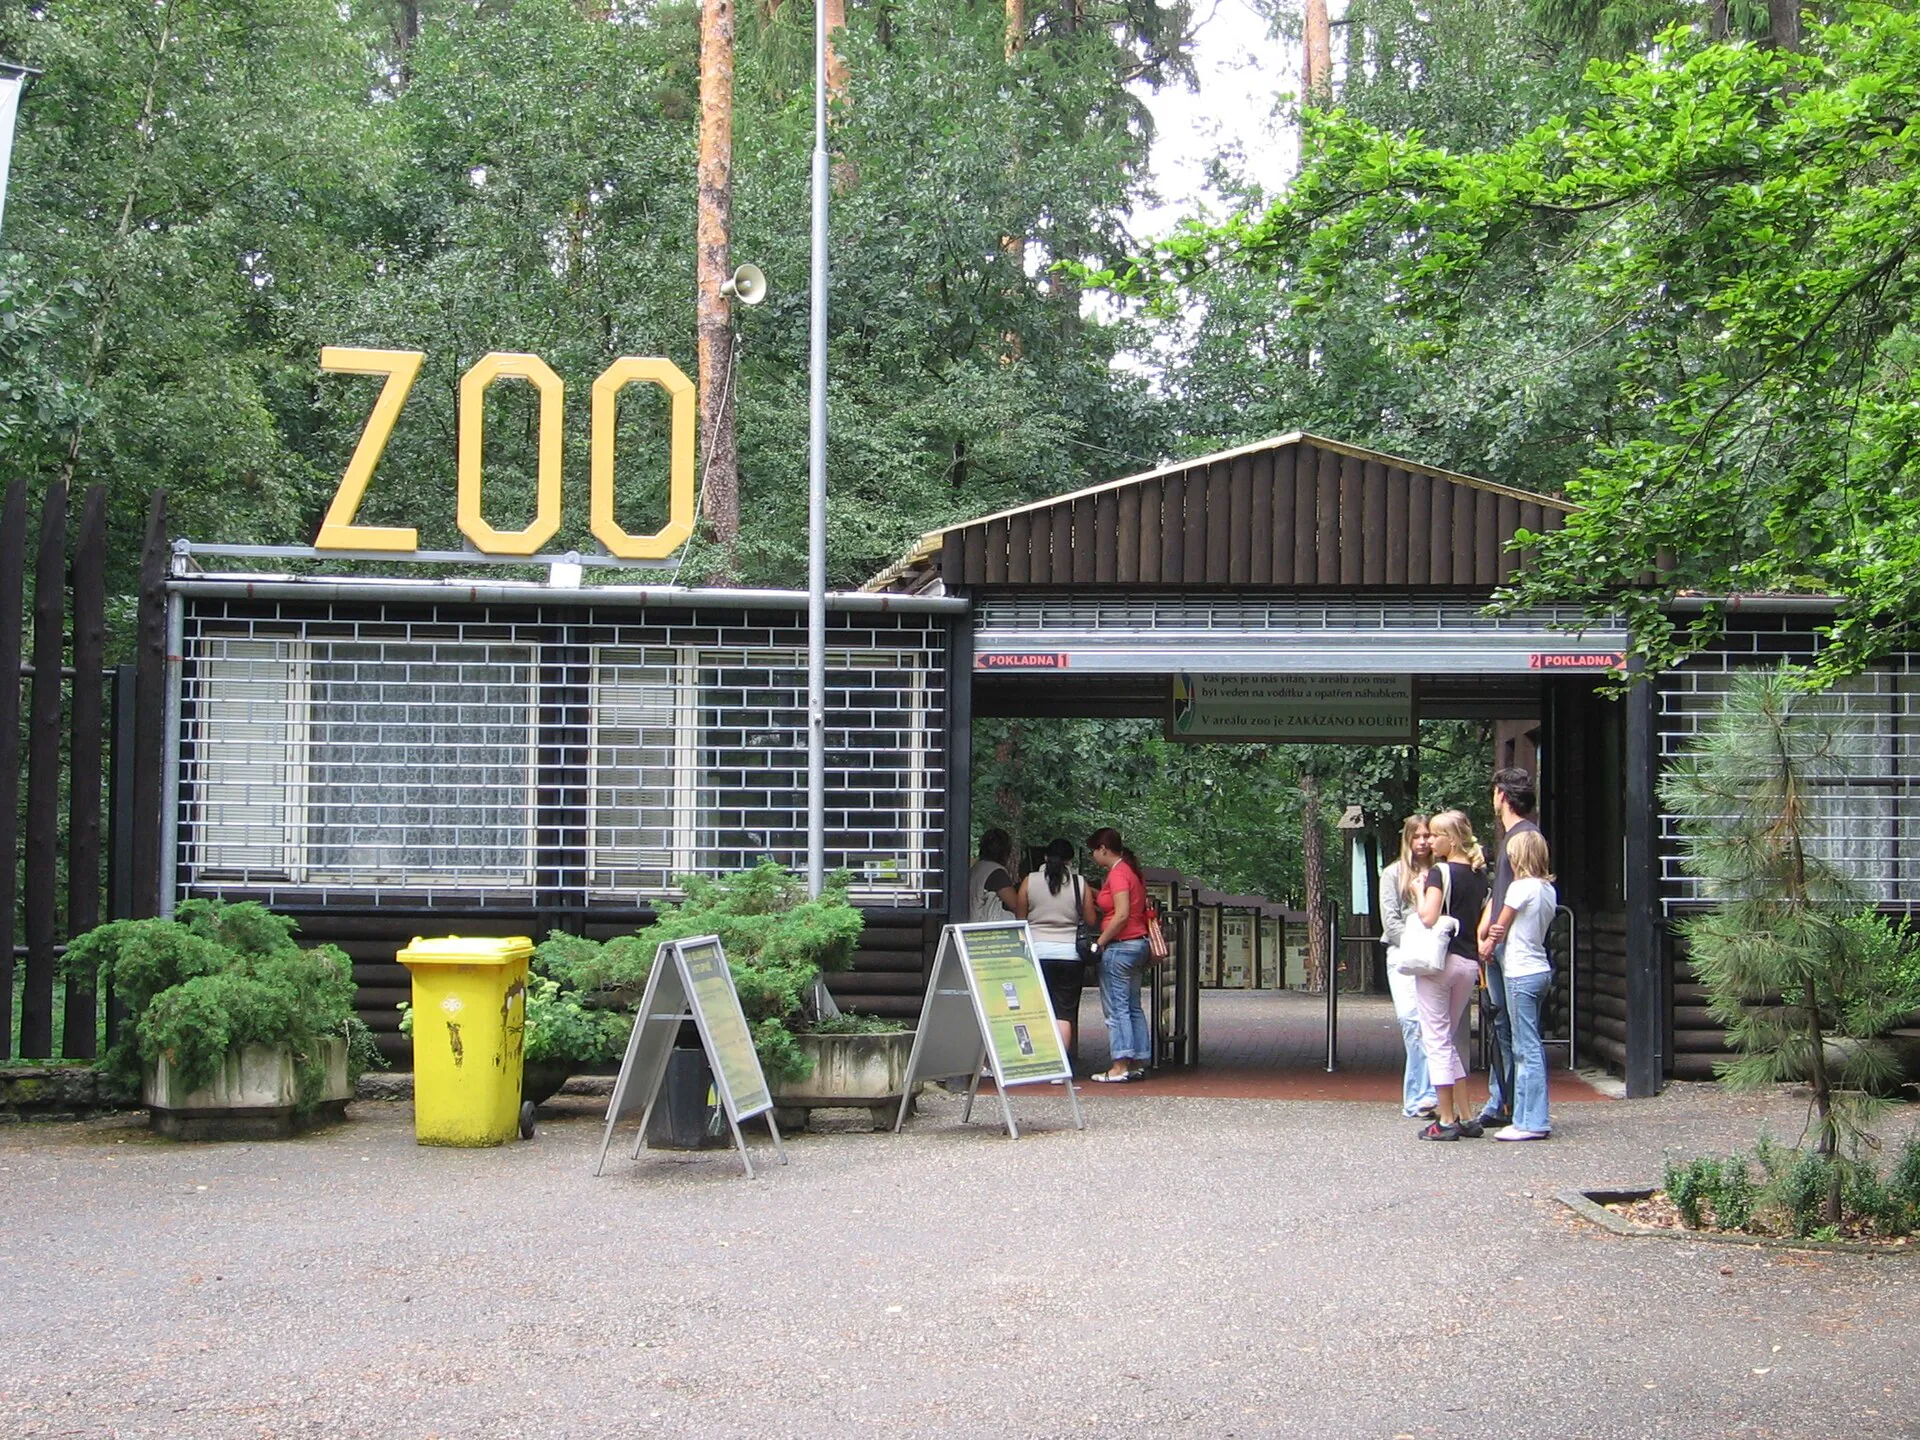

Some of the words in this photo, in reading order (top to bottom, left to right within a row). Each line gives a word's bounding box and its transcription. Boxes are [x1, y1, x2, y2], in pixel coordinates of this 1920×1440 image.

[315, 346, 696, 560] ZOO
[989, 655, 1055, 666] POKLADNA
[1531, 654, 1540, 668] 2
[1544, 655, 1613, 666] POKLADNA
[1221, 675, 1238, 685] pes
[1240, 674, 1250, 685] je
[1352, 676, 1370, 684] zoo
[1202, 687, 1217, 698] být
[1220, 687, 1249, 697] veden
[1267, 688, 1303, 698] vodítku
[1315, 689, 1352, 701] opatřen
[1201, 715, 1210, 725] V
[1213, 714, 1248, 725] areálu
[1250, 716, 1271, 726] zoo
[1274, 715, 1284, 727] je
[1287, 713, 1355, 727] ZAKÁZÁNO
[1358, 714, 1409, 728] KOUŘIT!
